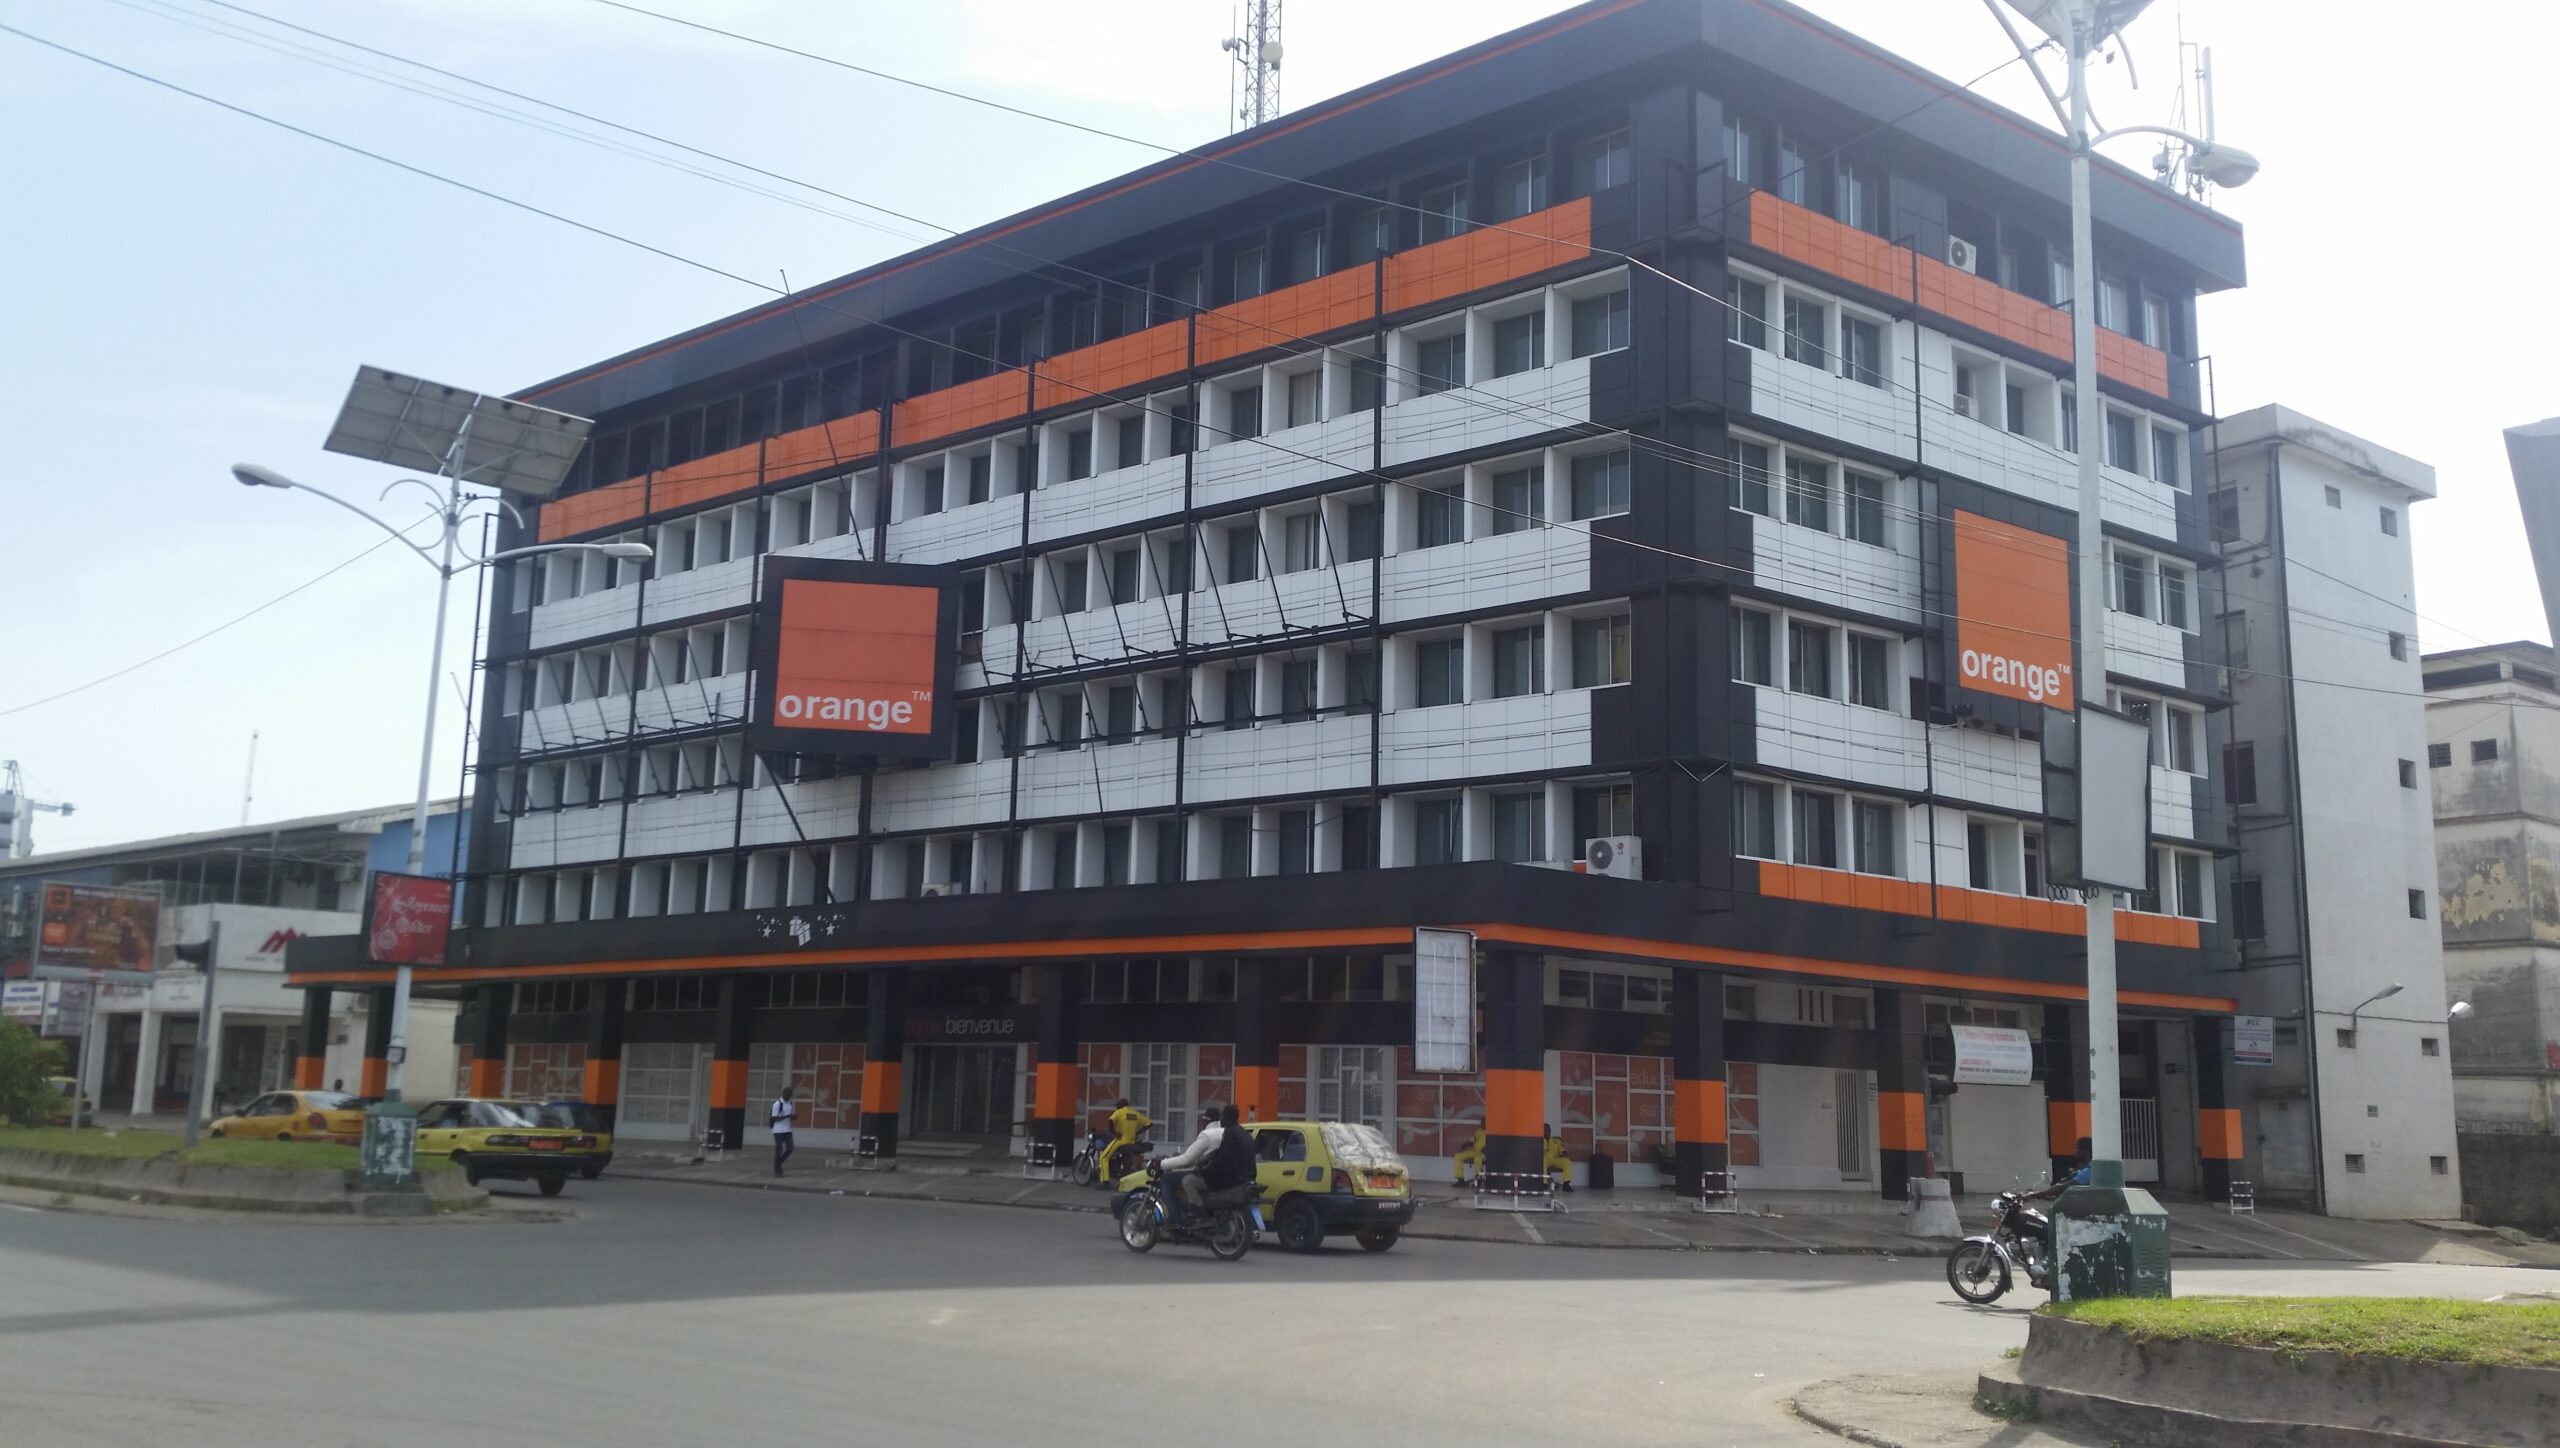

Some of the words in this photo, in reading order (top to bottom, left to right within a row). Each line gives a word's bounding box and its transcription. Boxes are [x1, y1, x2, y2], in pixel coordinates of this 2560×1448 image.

[1962, 650, 2060, 700] orange
[779, 695, 912, 730] orange
[945, 1015, 1014, 1034] bienvenue
